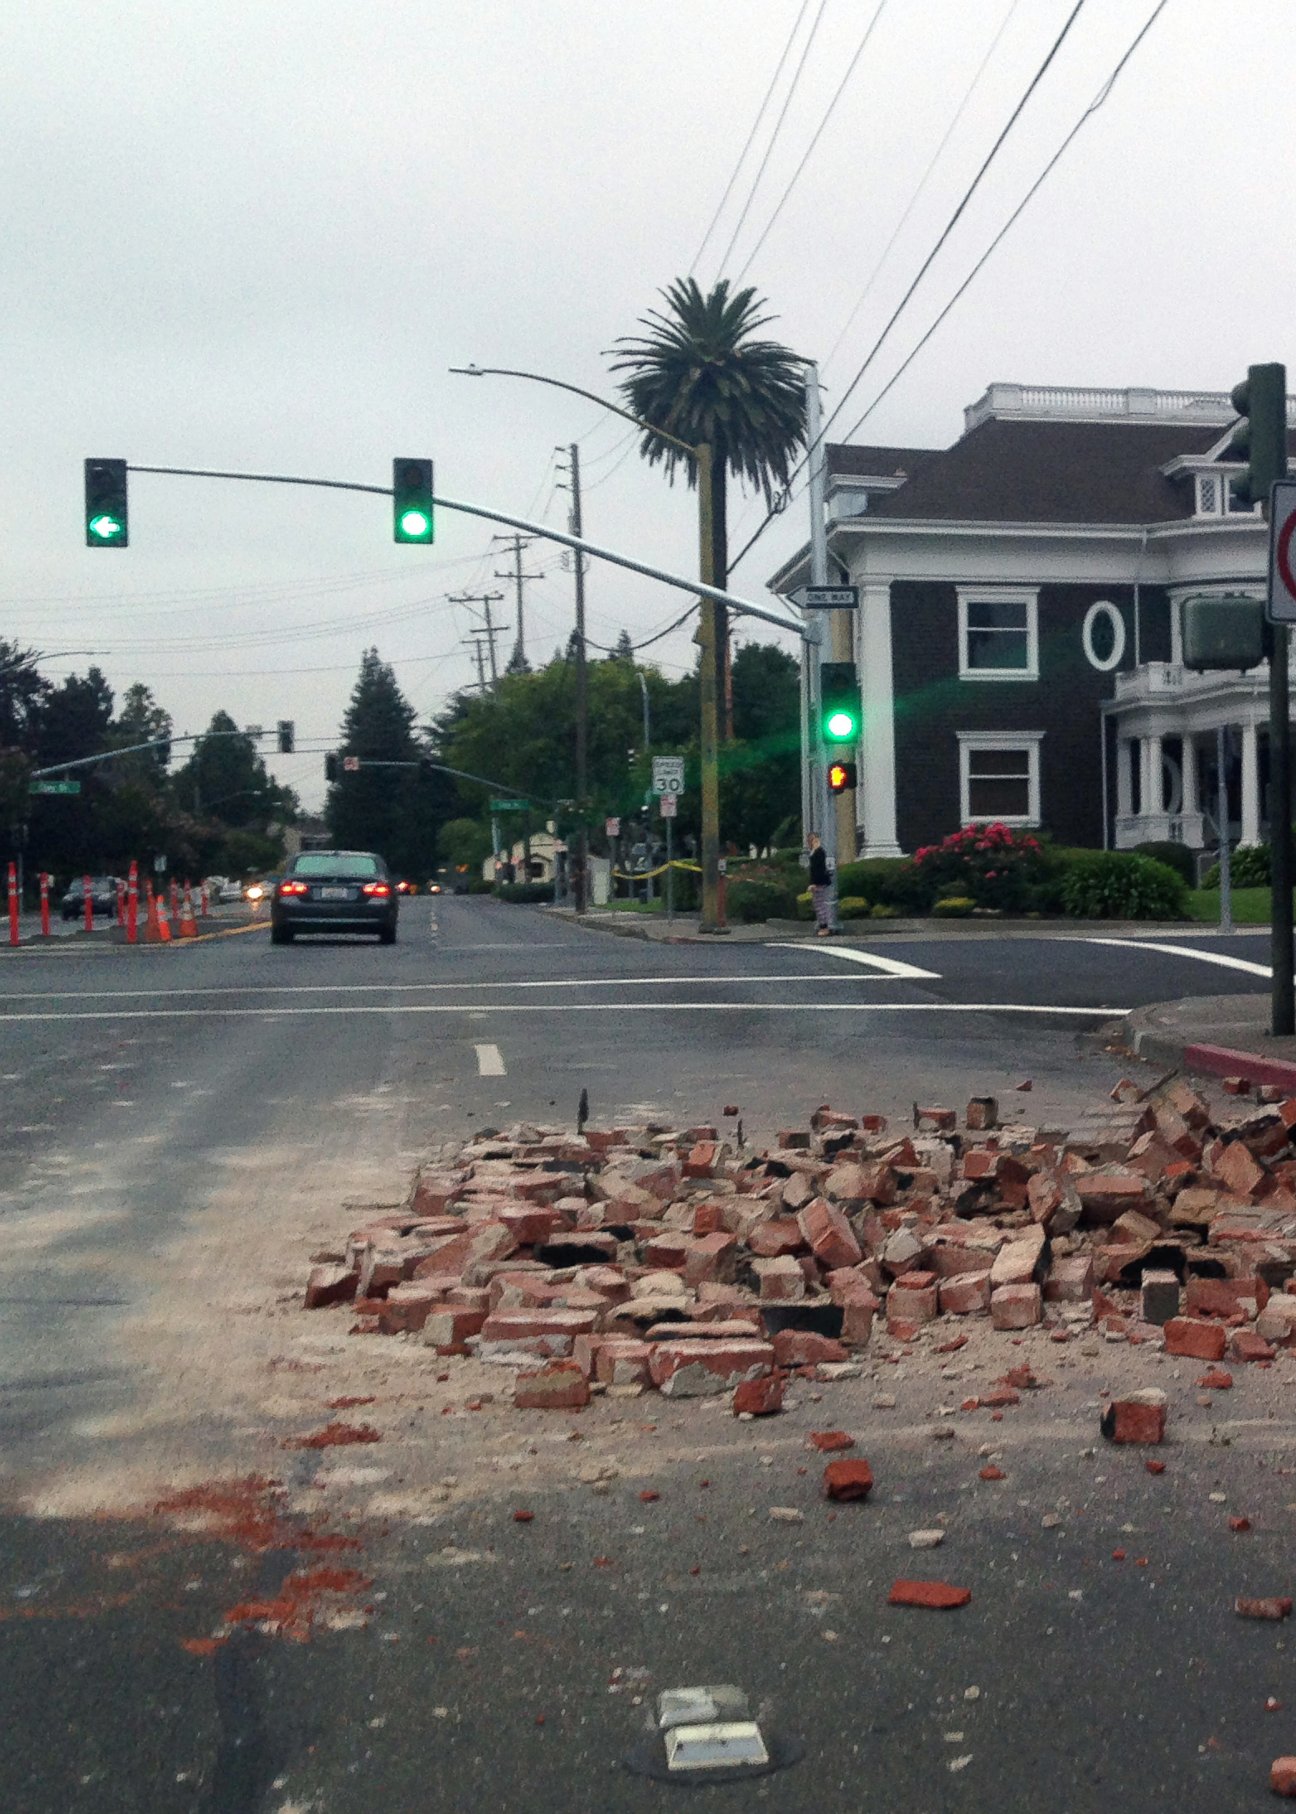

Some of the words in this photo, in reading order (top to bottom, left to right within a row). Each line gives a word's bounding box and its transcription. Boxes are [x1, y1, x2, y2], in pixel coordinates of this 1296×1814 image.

[807, 593, 827, 602] ONE
[831, 593, 850, 602] WAY
[657, 778, 680, 792] 30
